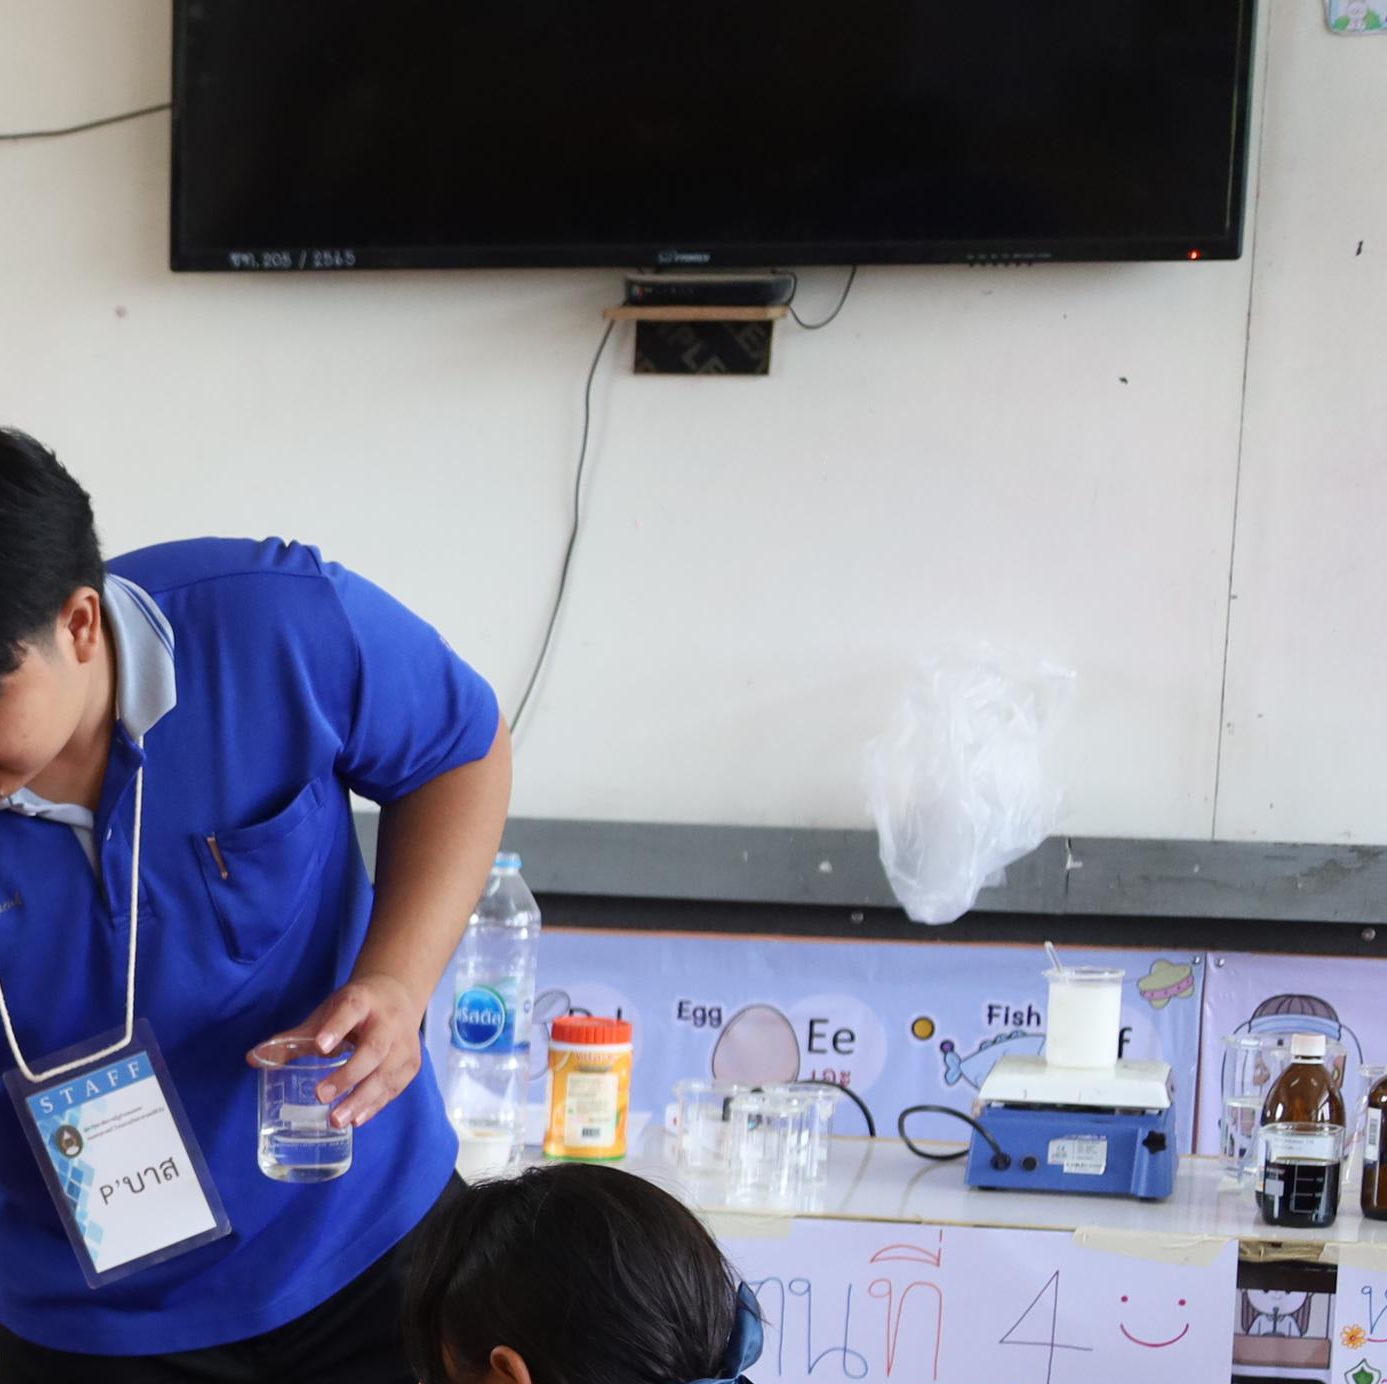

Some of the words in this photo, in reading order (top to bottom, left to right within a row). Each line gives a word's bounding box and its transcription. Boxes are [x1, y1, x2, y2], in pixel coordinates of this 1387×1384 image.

[678, 1000, 723, 1027] Egg
[987, 1004, 1042, 1027] Fish
[807, 1019, 856, 1055] Ee
[39, 1061, 142, 1114] STAFF
[749, 1229, 943, 1380] านที่
